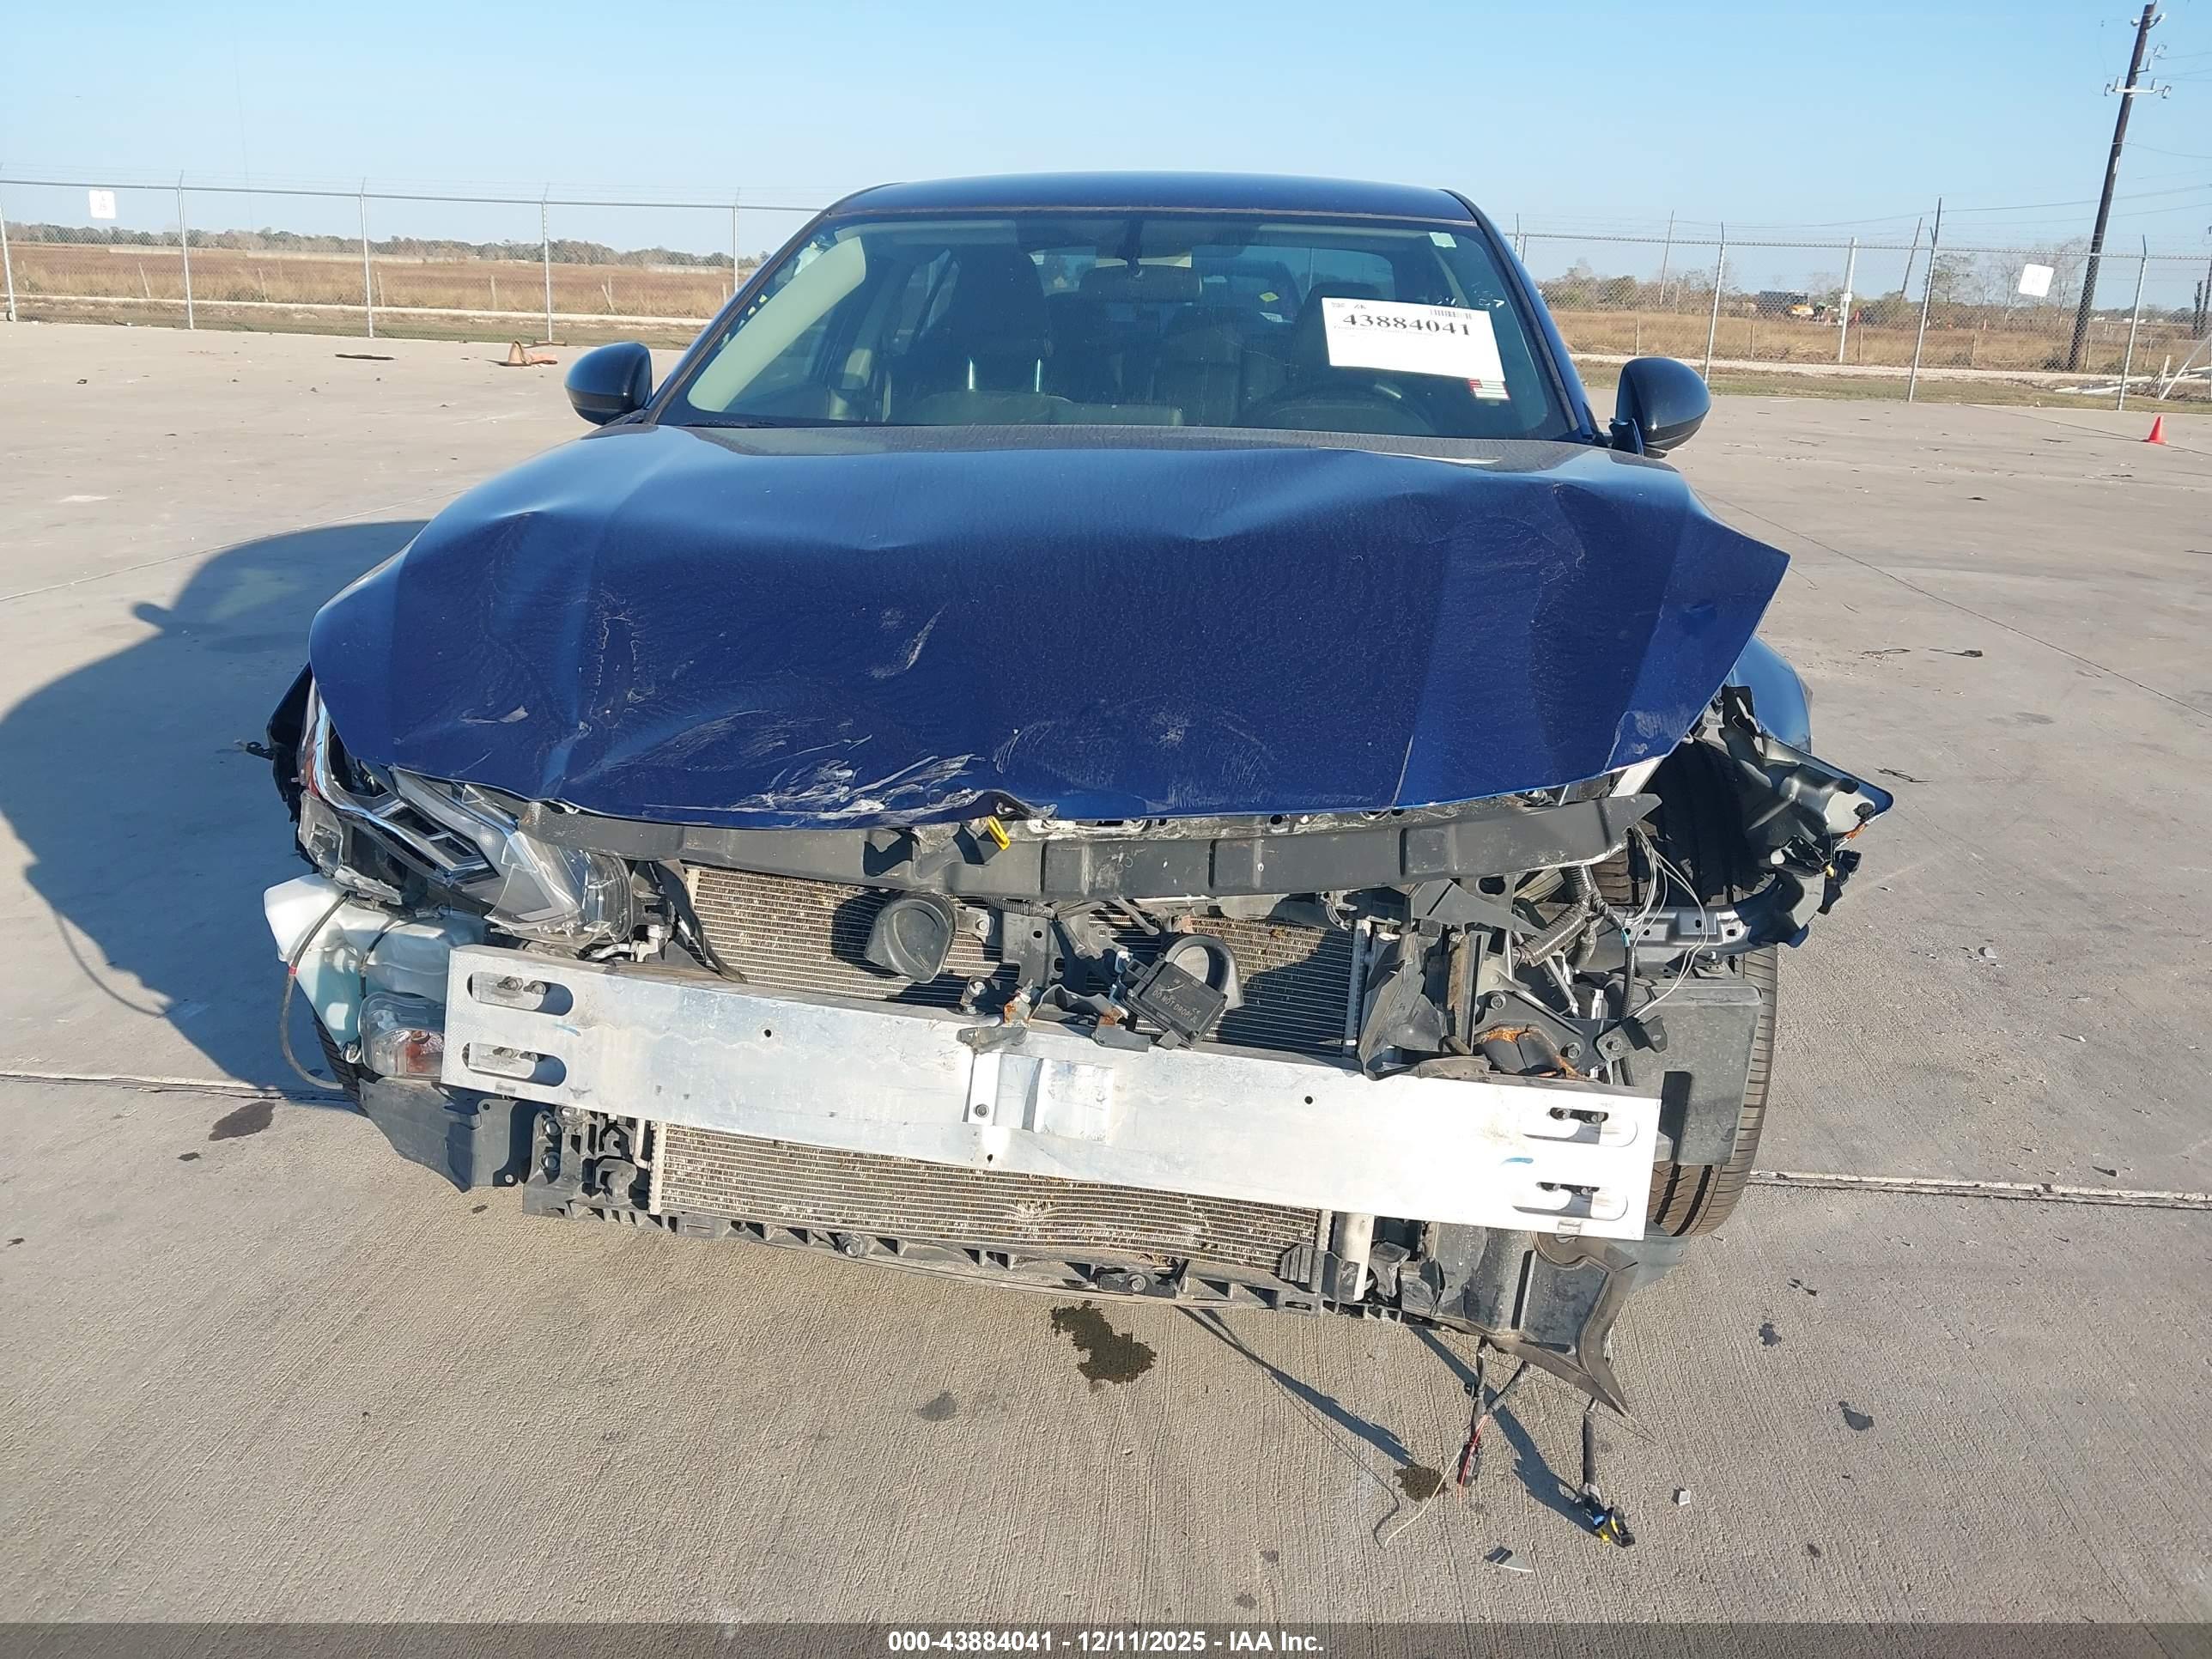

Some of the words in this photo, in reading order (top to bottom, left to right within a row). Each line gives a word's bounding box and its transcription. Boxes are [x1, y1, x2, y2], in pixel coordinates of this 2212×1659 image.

[1343, 313, 1470, 336] 43884041
[1152, 989, 1163, 998] DO
[1161, 994, 1176, 1007] NOT
